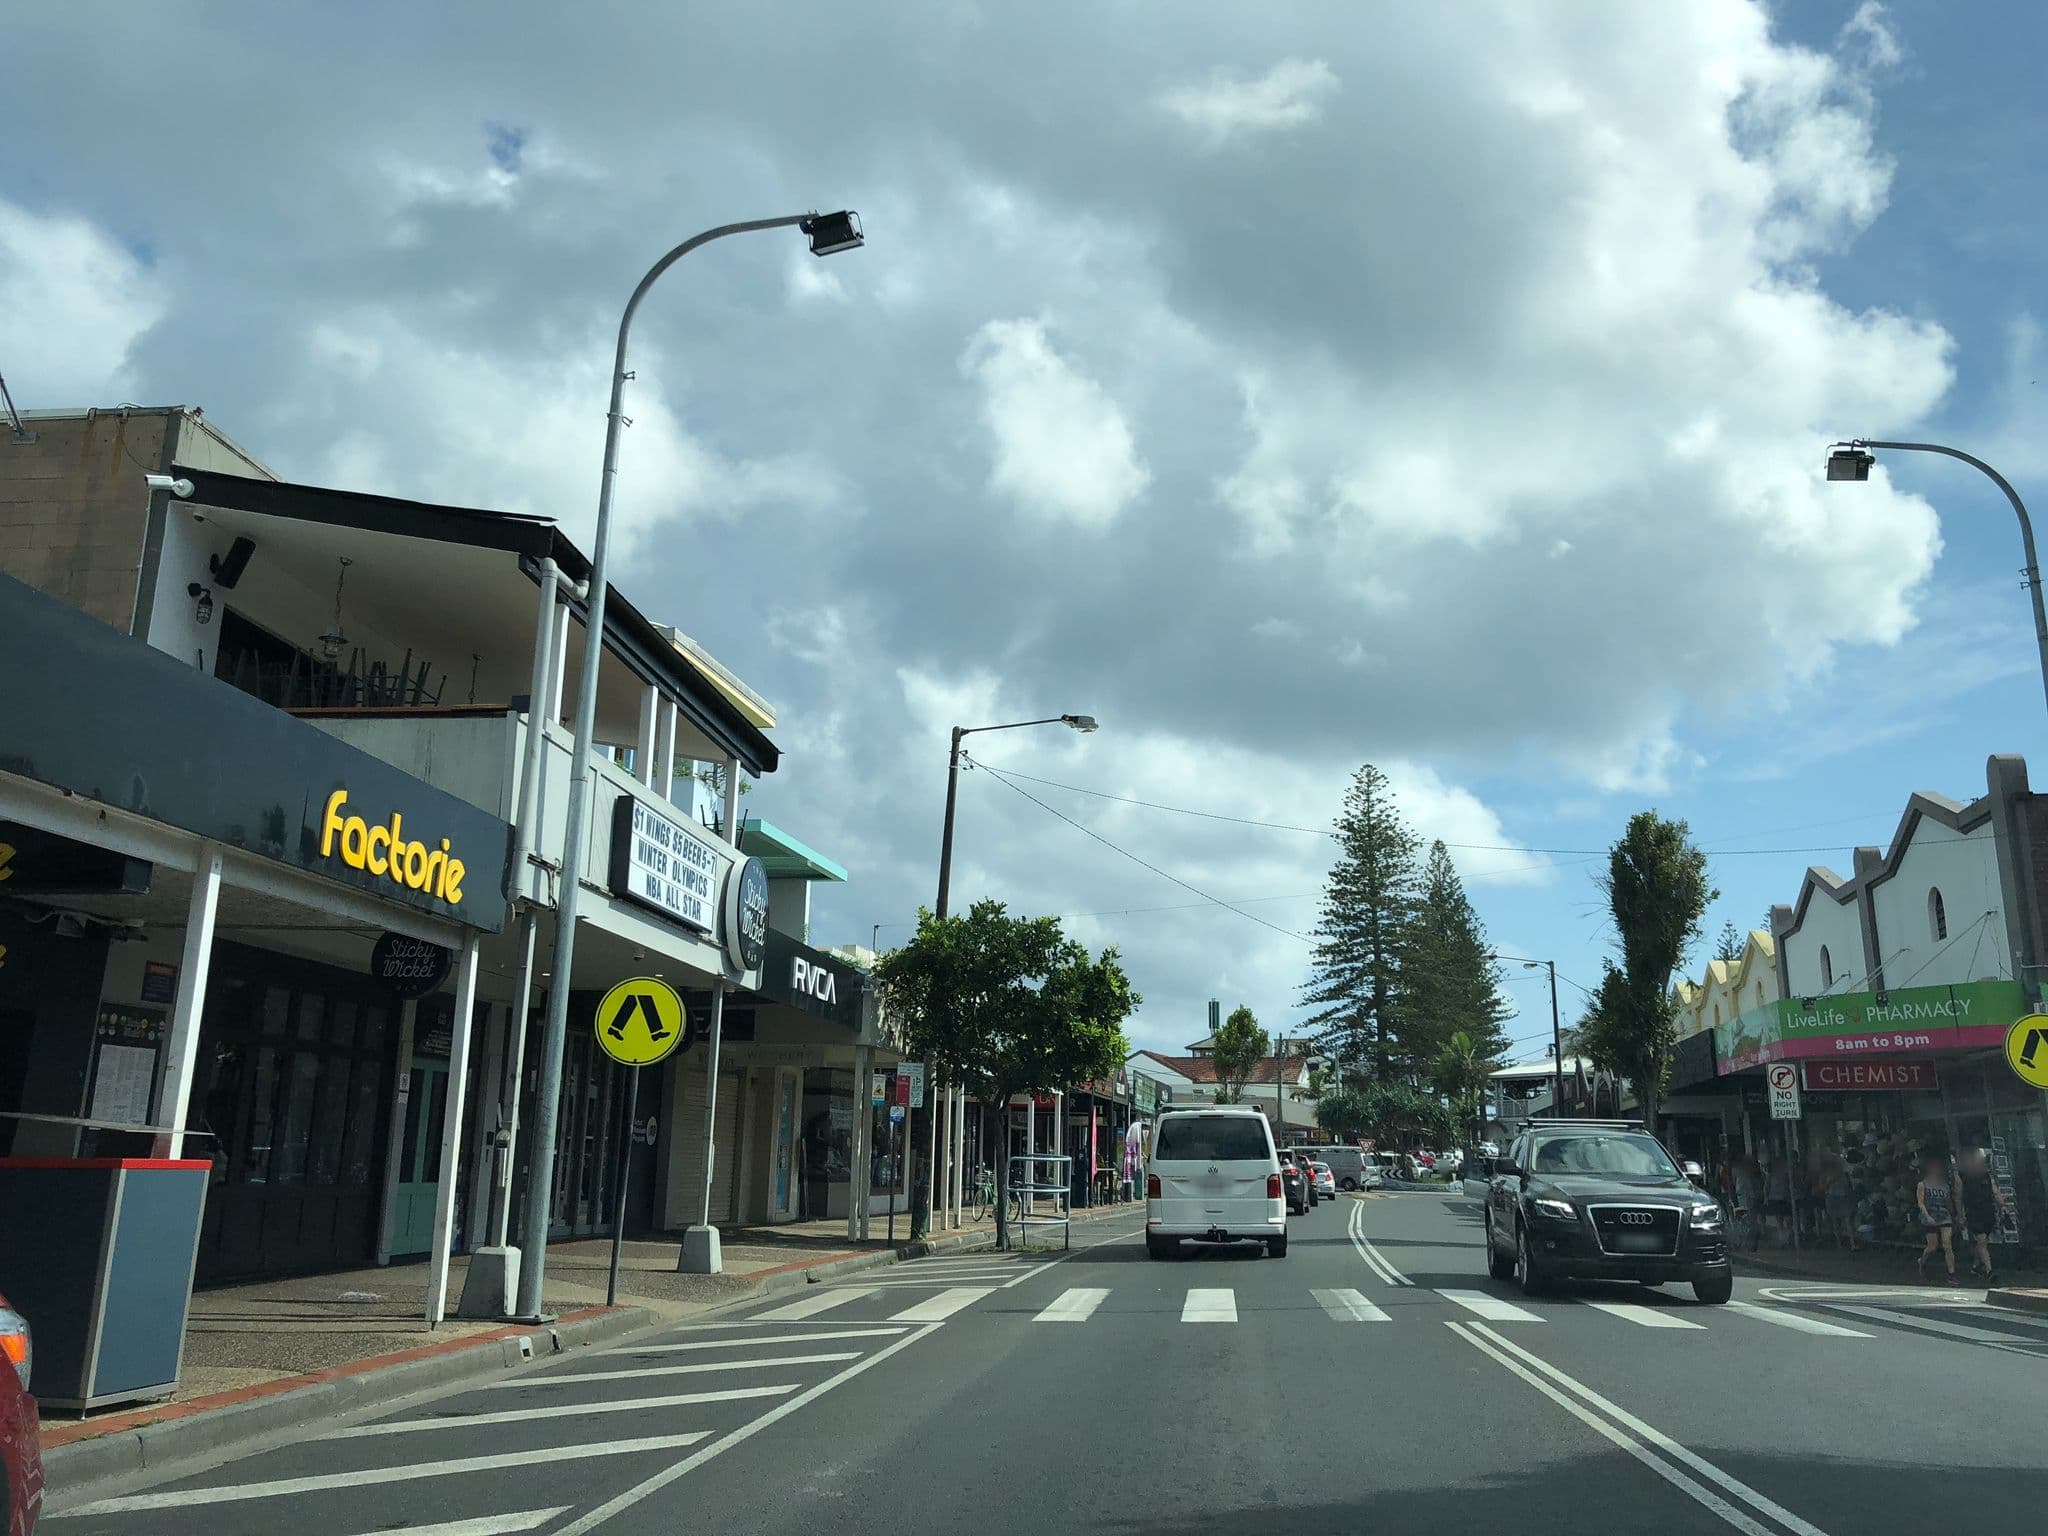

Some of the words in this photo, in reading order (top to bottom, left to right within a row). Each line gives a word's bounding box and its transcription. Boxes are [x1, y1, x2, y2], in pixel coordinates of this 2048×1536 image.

[634, 805, 644, 831] $1
[646, 814, 671, 848] WINGS
[320, 789, 466, 904] factorie
[638, 838, 667, 875] WINTER
[672, 860, 708, 898] OLYMPICS
[646, 874, 661, 901] NBA
[666, 885, 680, 910] ALL
[683, 894, 701, 921] STAR
[744, 878, 766, 925] Sticky
[742, 907, 766, 946] Wicket
[385, 939, 436, 964] Sticky
[383, 960, 436, 978] Wicket
[793, 956, 837, 1005] RVCA
[1787, 1007, 1845, 1028] LiveLife
[1866, 998, 1971, 1022] PHARMACY
[1835, 1038, 1868, 1050] 8am
[1872, 1037, 1889, 1047] to
[1895, 1034, 1930, 1049] 8pm
[1820, 1066, 1921, 1084] CHEMIST
[1774, 1101, 1796, 1109] RIGHT
[1776, 1091, 1792, 1100] NO
[1775, 1109, 1797, 1117] TURN
